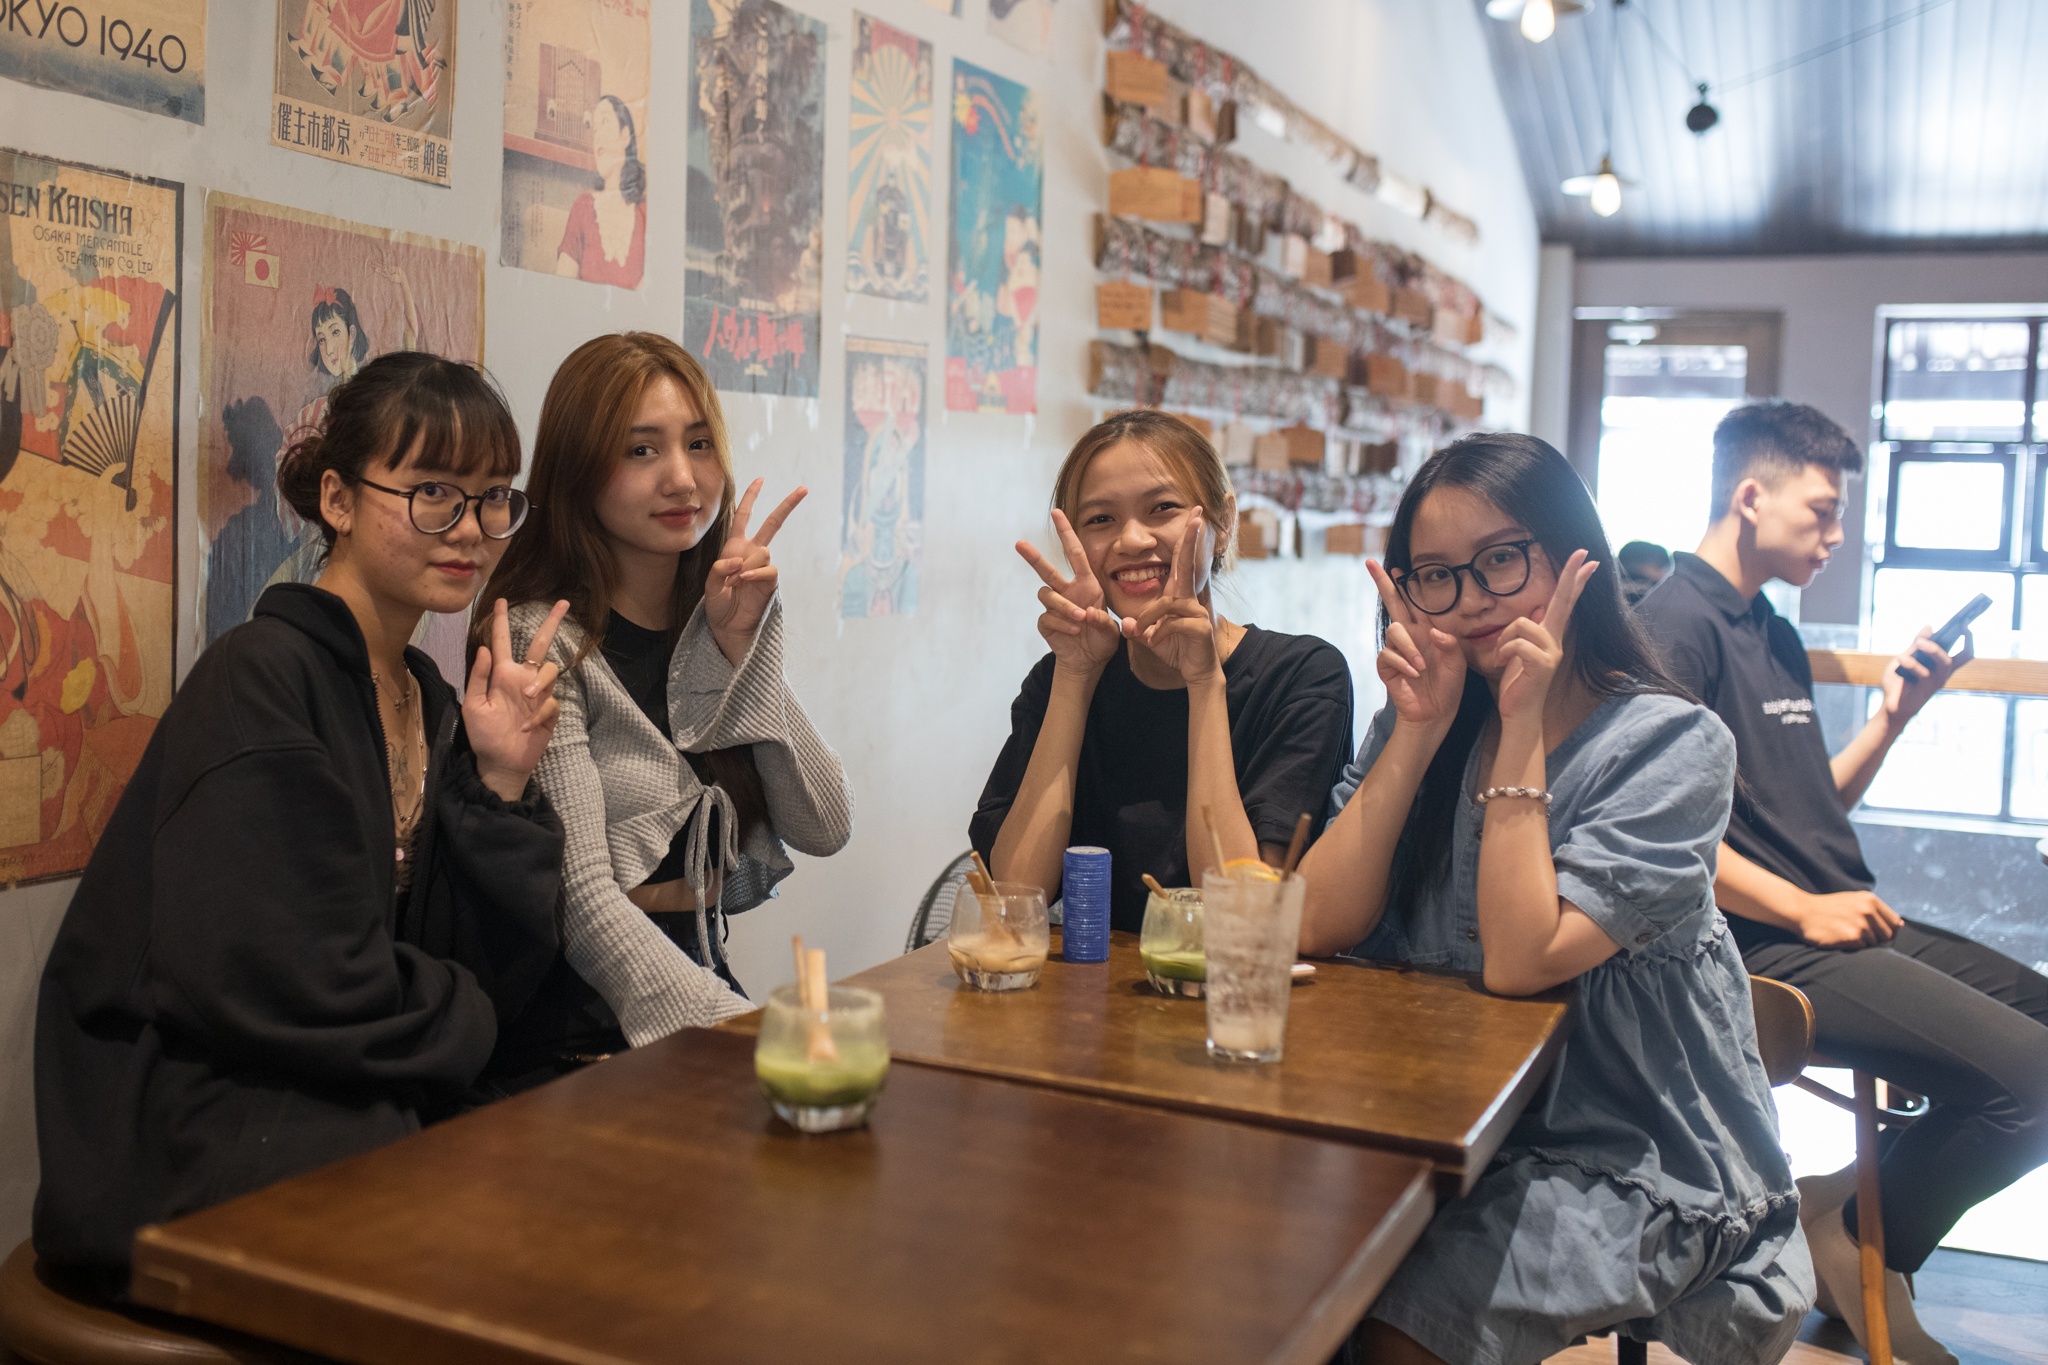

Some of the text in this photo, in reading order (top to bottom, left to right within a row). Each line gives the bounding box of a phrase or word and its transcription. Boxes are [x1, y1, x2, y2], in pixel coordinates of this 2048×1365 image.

[0, 0, 186, 73] KYO 1940
[48, 185, 133, 236] KAISHA
[33, 225, 143, 256] OSAKA MERCANTILE
[57, 246, 114, 269] STEAMSHIP
